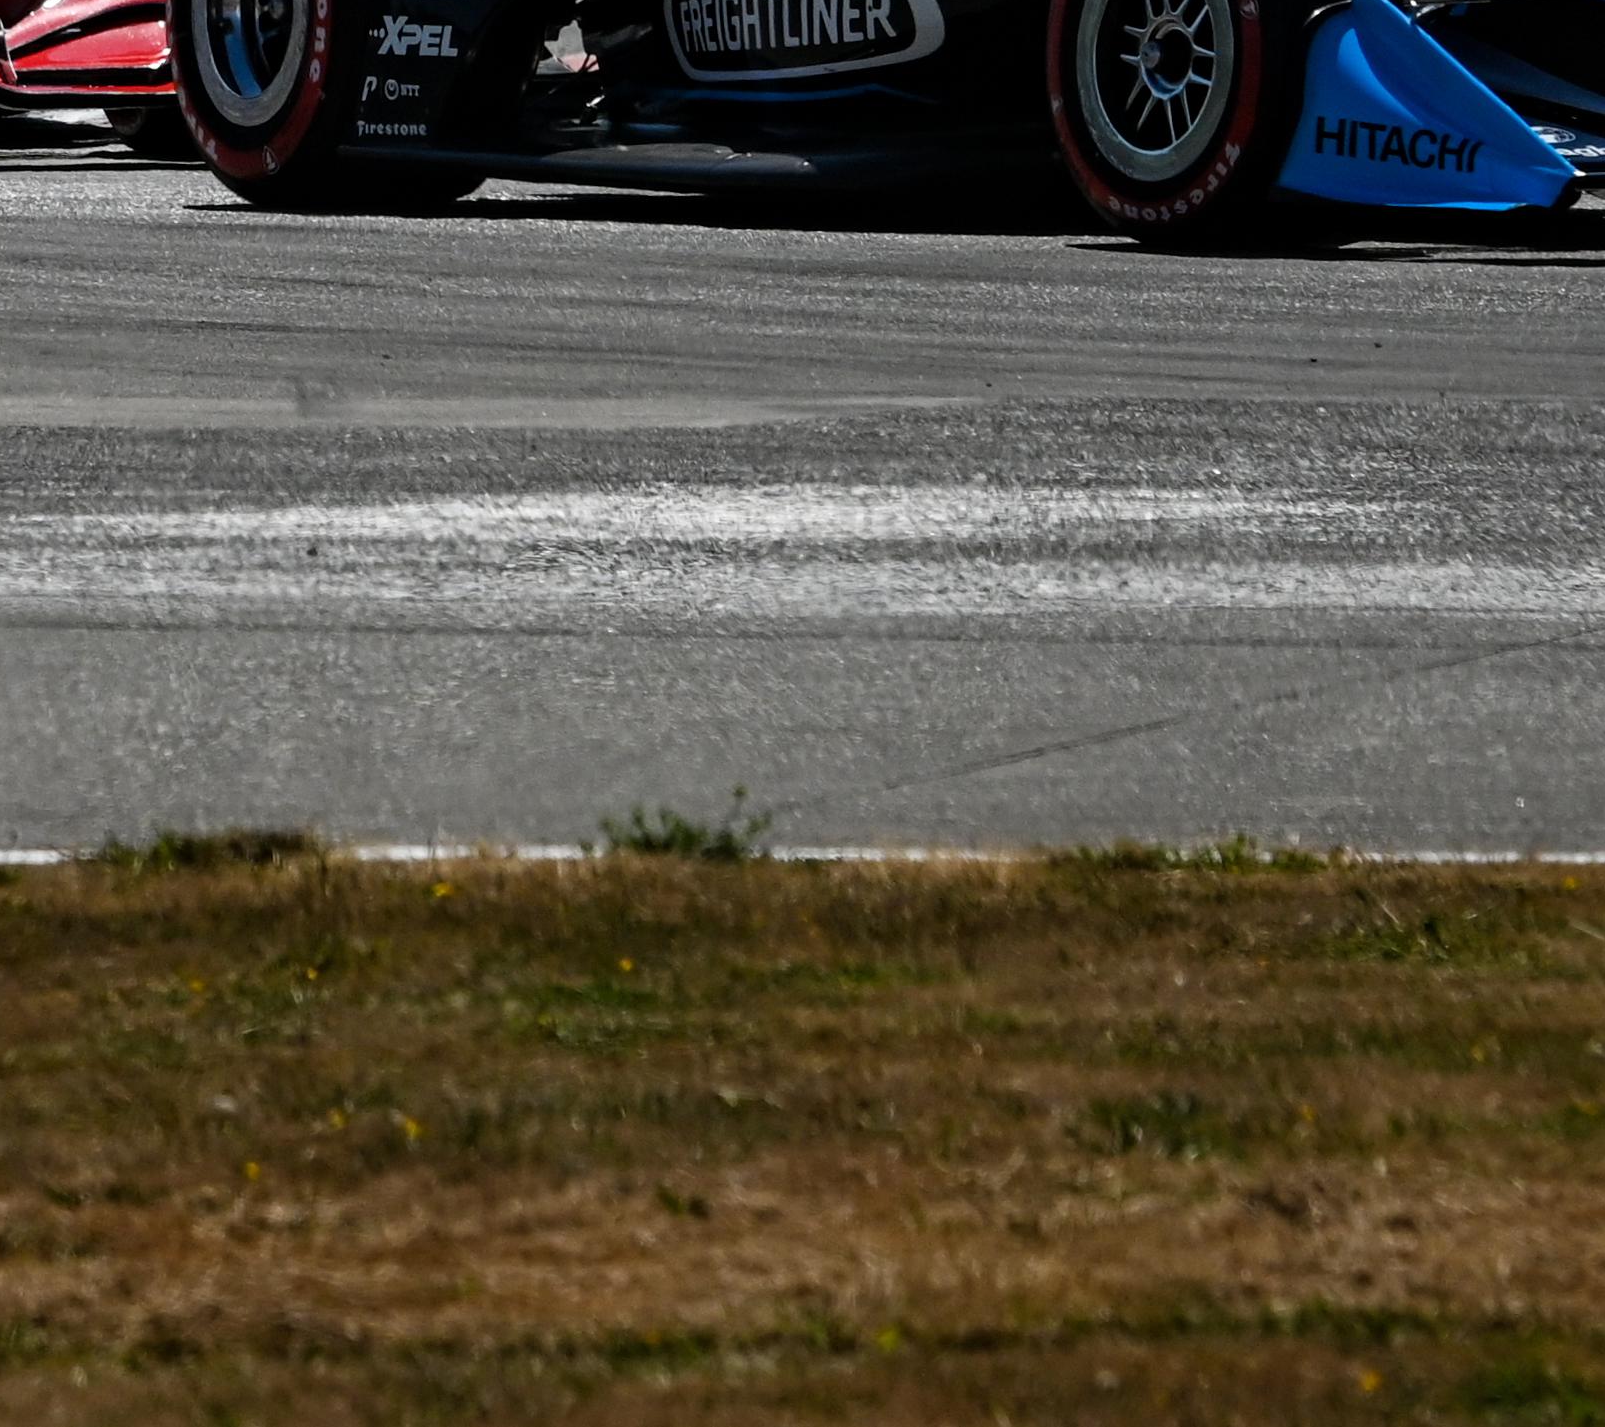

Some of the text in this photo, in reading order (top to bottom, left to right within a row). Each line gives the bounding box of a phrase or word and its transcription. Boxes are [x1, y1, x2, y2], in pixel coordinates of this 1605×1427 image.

[376, 14, 459, 58] XPEL
[356, 119, 429, 138] Firestone
[1314, 115, 1482, 174] HITACHI
